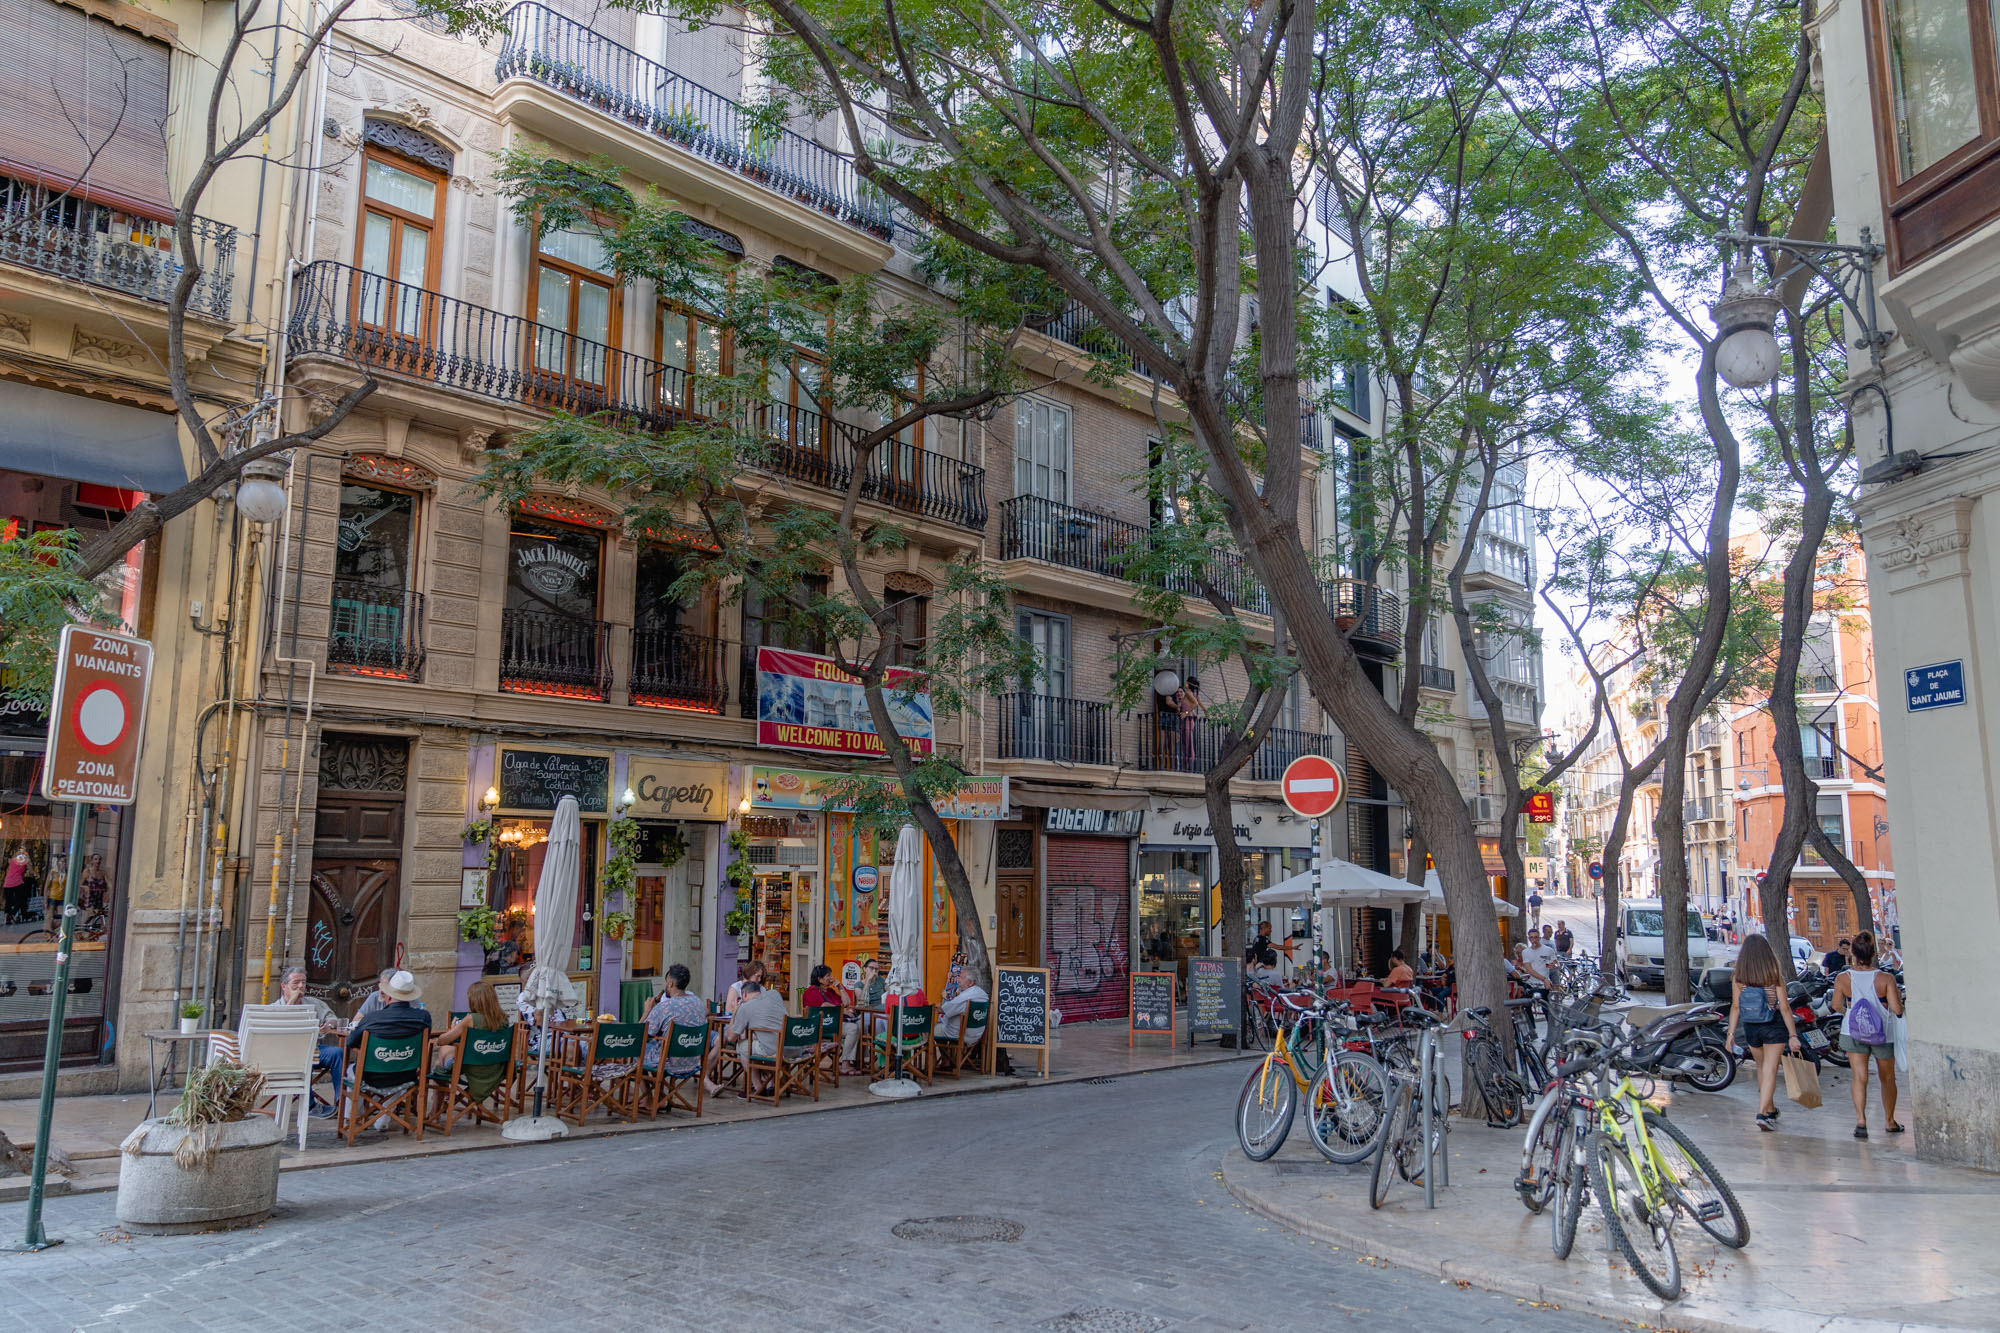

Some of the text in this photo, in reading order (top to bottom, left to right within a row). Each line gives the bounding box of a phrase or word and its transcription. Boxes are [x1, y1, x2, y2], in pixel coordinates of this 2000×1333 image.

[518, 547, 546, 567] JACK
[92, 637, 130, 657] ZONA
[74, 652, 143, 679] VIANANTS
[1927, 669, 1949, 680] PLAÇA
[1929, 681, 1940, 690] DE
[1911, 689, 1962, 706] SANT JAUME
[777, 724, 842, 748] WELCOME
[845, 732, 862, 750] TO
[76, 760, 115, 778] ZONA
[530, 756, 541, 770] de
[57, 778, 127, 798] PEATONAL
[1046, 806, 1105, 832] EUGENIO
[1026, 974, 1041, 985] de
[473, 1039, 508, 1055] Carlsberg
[603, 1034, 636, 1048] Carlsberg
[374, 1045, 416, 1063] Carlsberg
